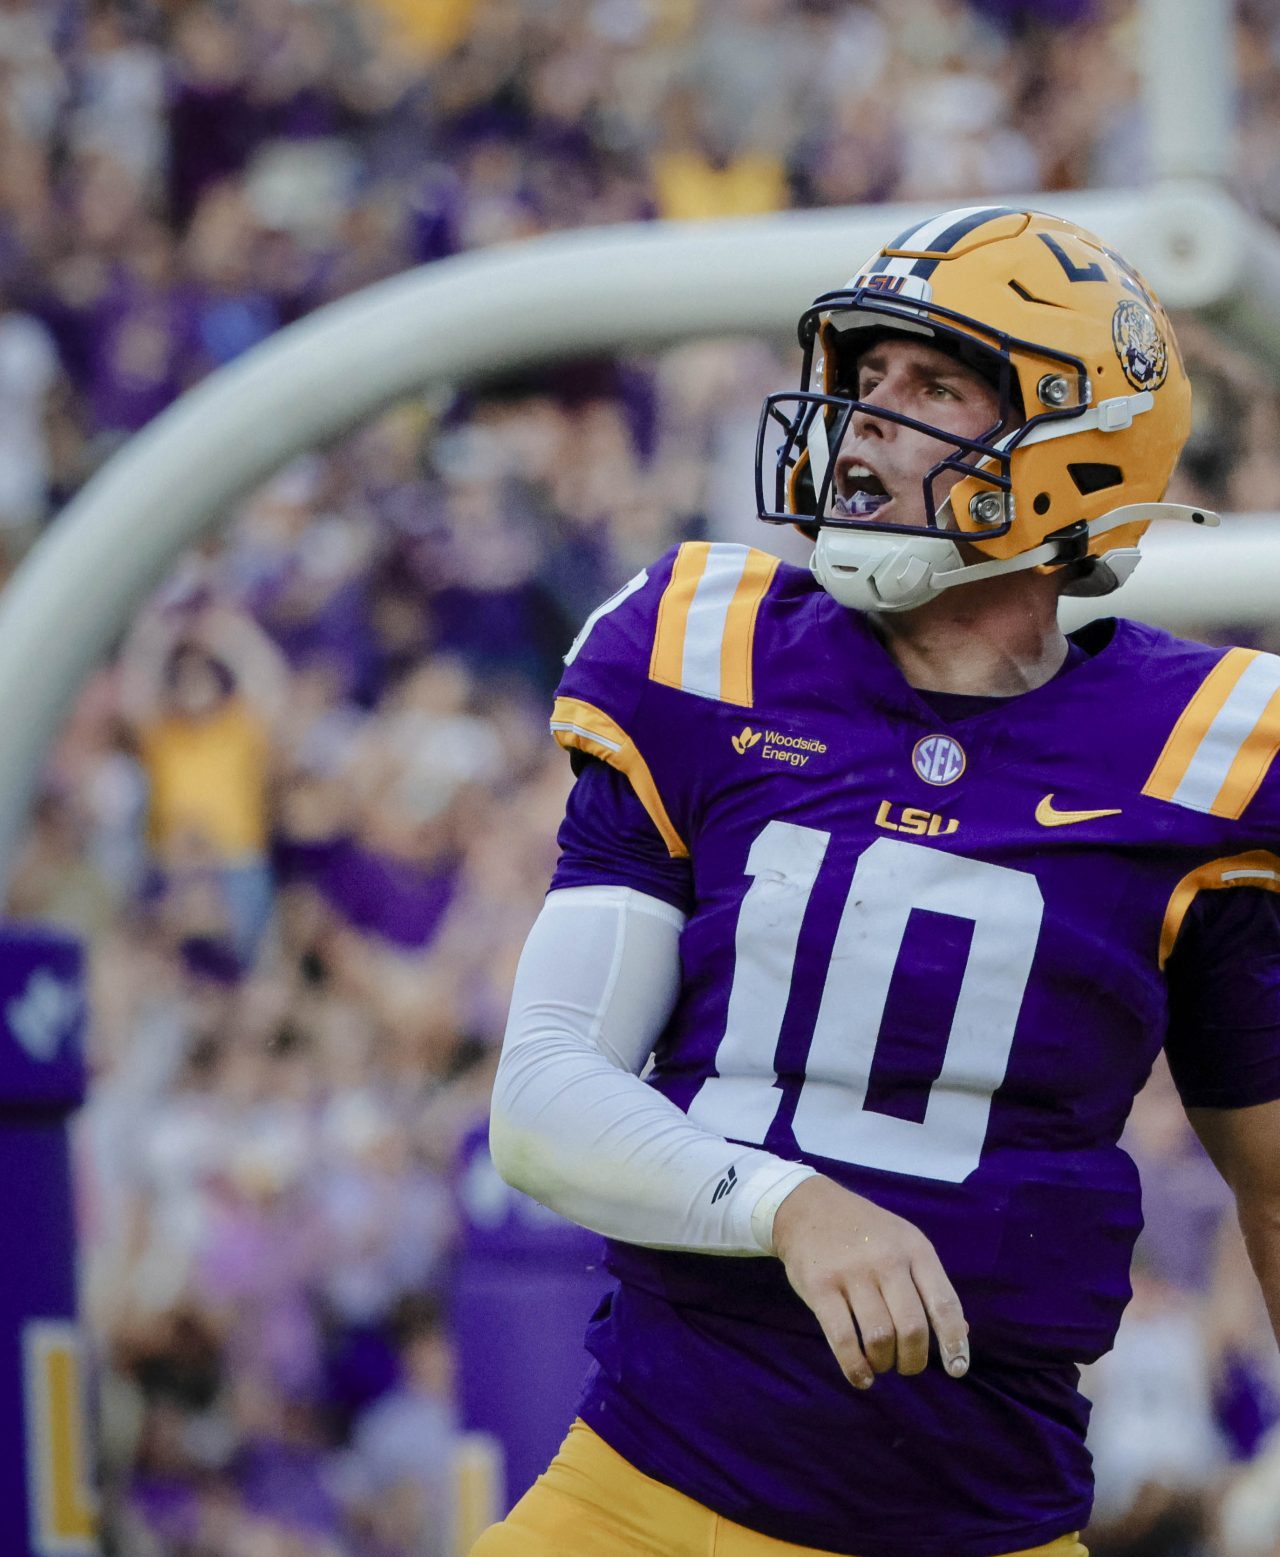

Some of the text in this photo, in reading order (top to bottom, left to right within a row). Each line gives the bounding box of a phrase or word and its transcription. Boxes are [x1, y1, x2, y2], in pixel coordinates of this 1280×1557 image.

[762, 745, 810, 767] Energy
[764, 730, 827, 754] Woodside
[916, 737, 963, 782] SEC
[874, 800, 960, 836] LSU
[688, 820, 1045, 1183] 10
